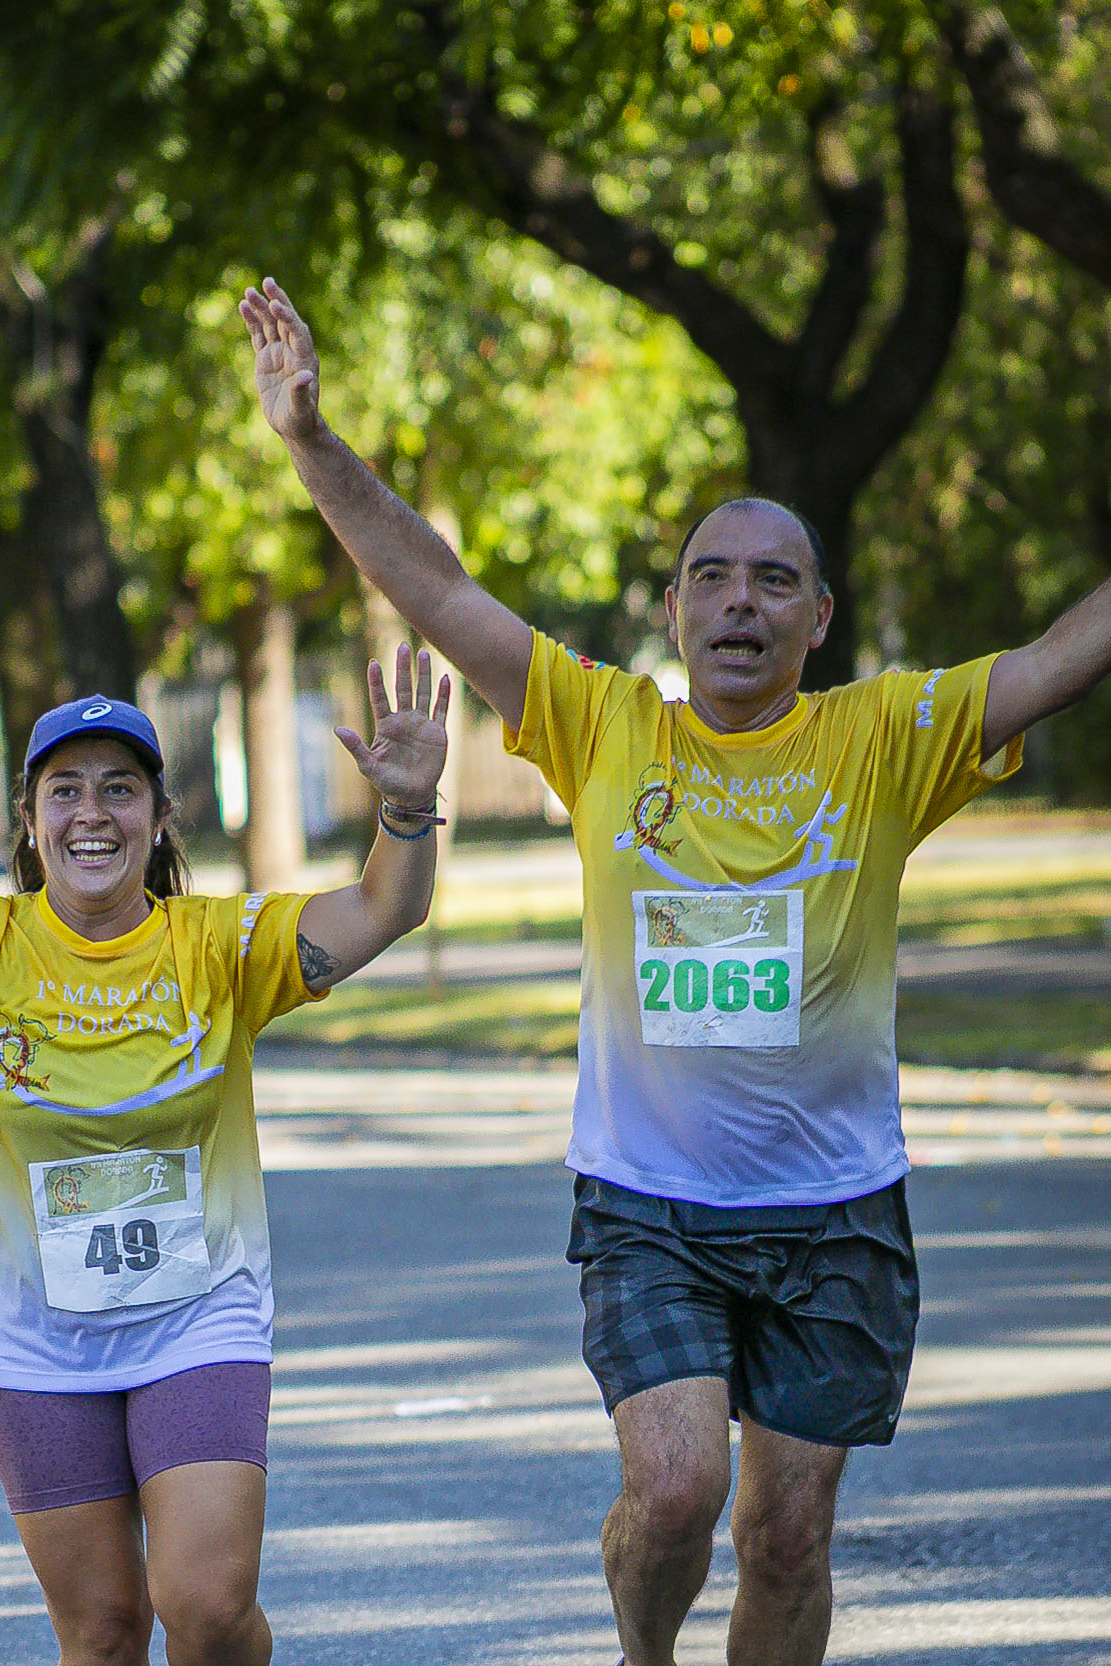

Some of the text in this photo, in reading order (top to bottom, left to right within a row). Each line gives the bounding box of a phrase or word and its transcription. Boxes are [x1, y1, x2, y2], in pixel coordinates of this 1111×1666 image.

[690, 764, 816, 797] MARATÓN
[682, 791, 795, 826] DORADA
[640, 958, 790, 1013] 2063
[56, 1011, 171, 1035] DORADA
[84, 1218, 161, 1276] 49
